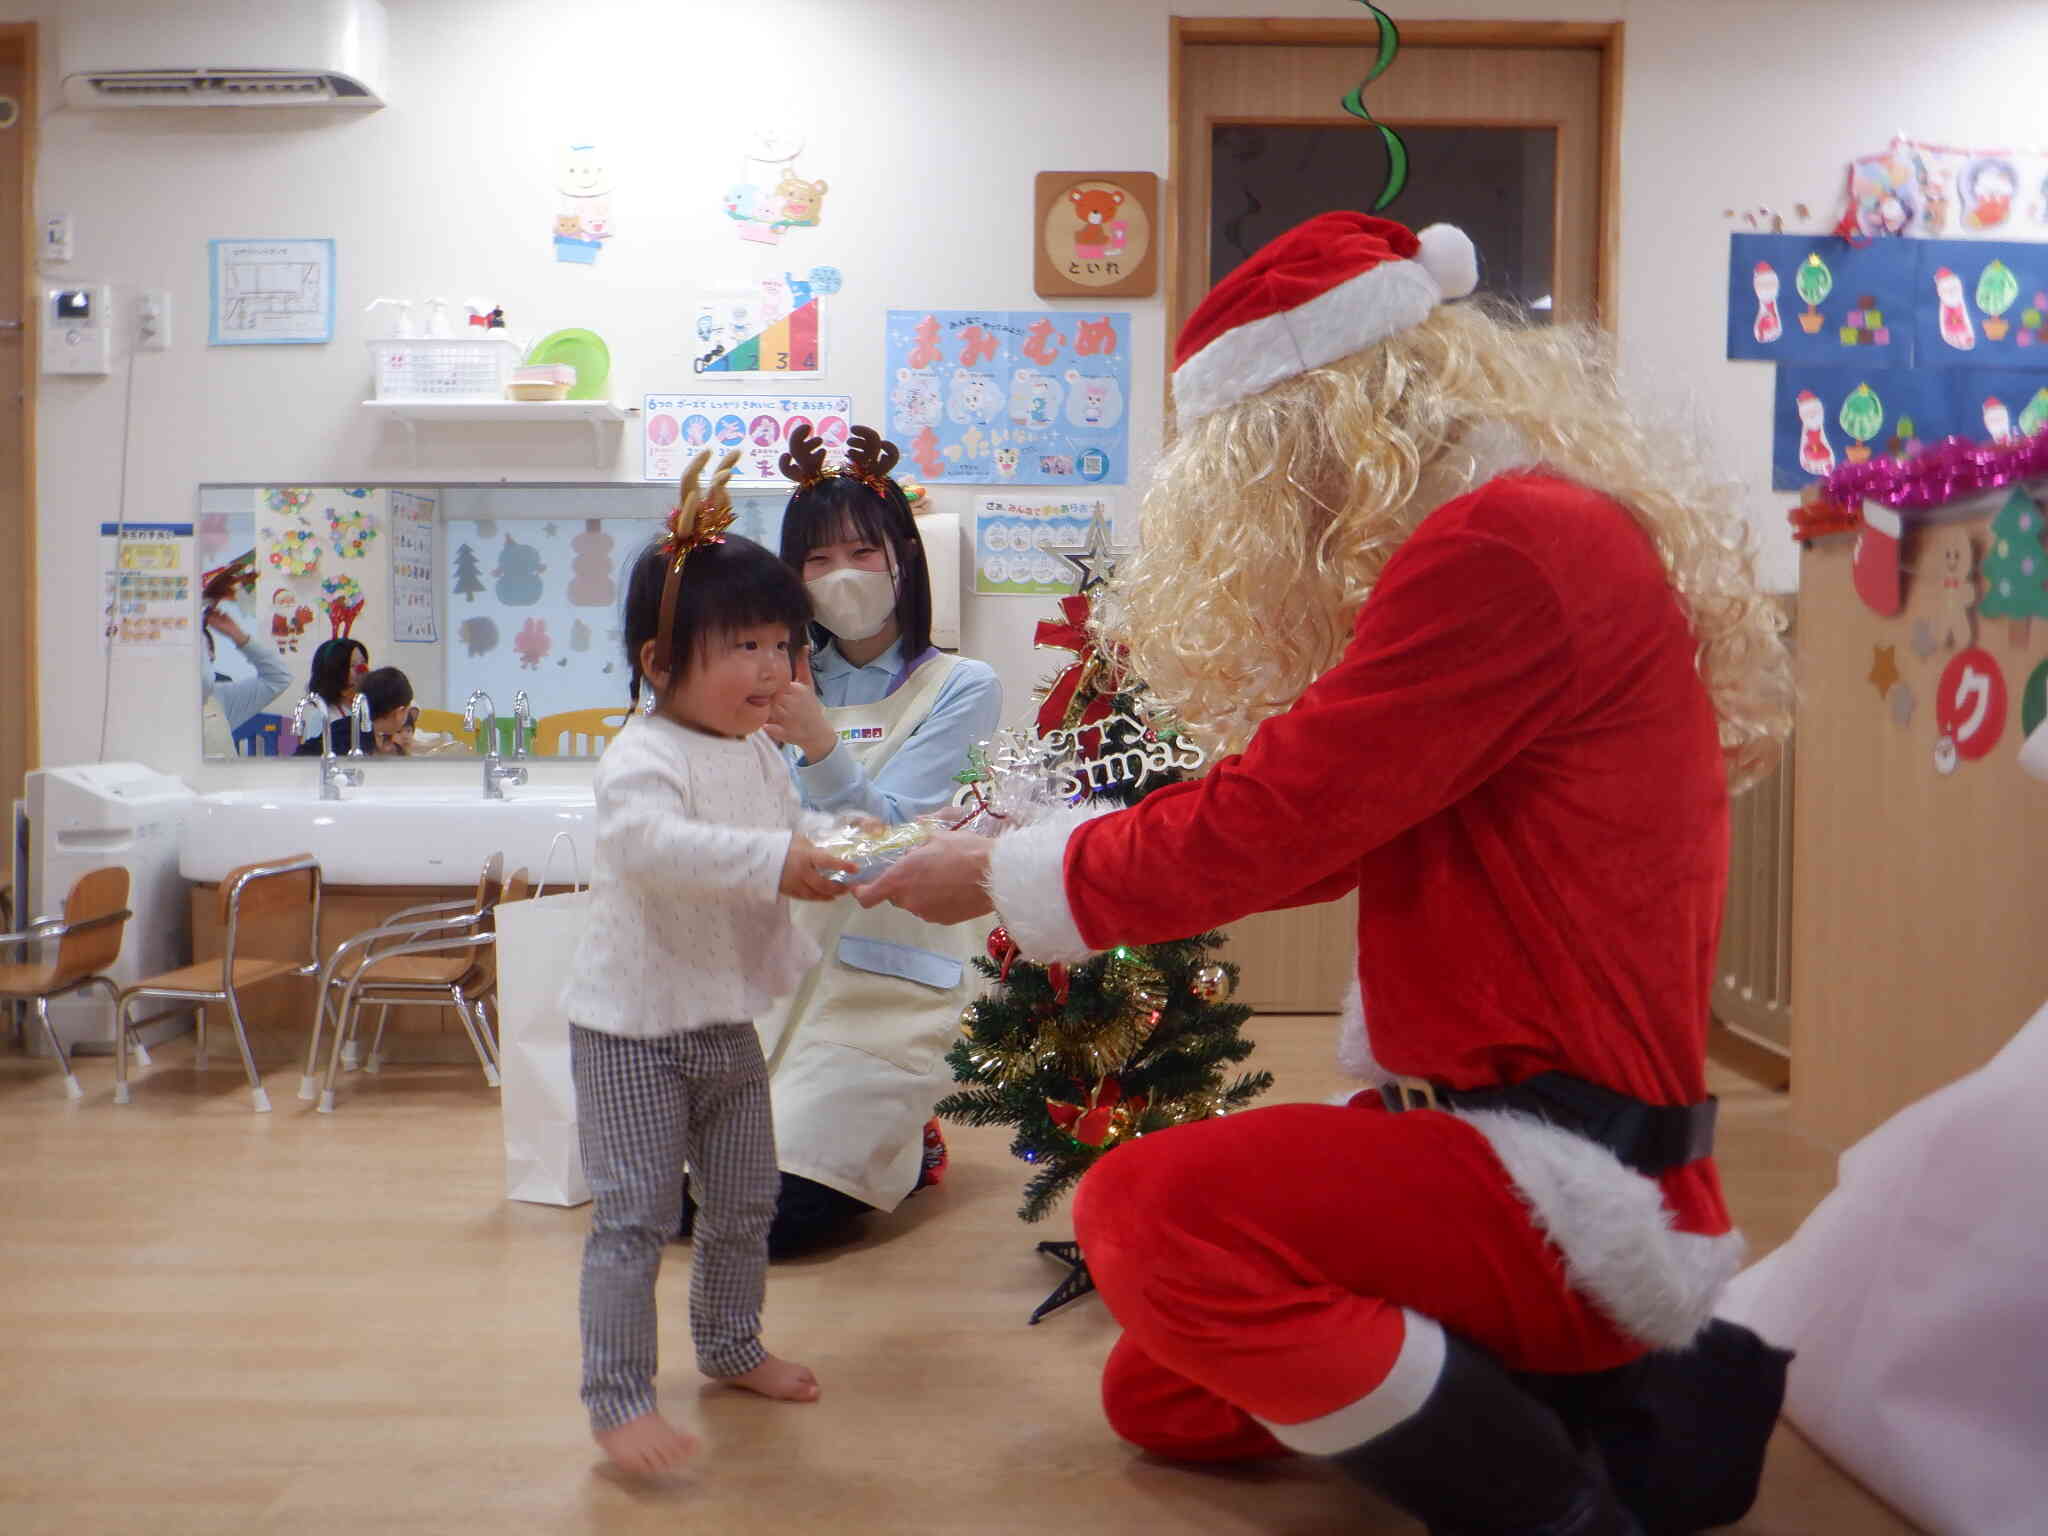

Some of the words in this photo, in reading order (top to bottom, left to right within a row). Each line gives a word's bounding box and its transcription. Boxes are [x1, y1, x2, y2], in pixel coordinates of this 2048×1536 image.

[1069, 262, 1120, 274] といれ
[776, 352, 789, 370] 3
[1955, 666, 1990, 741] ク
